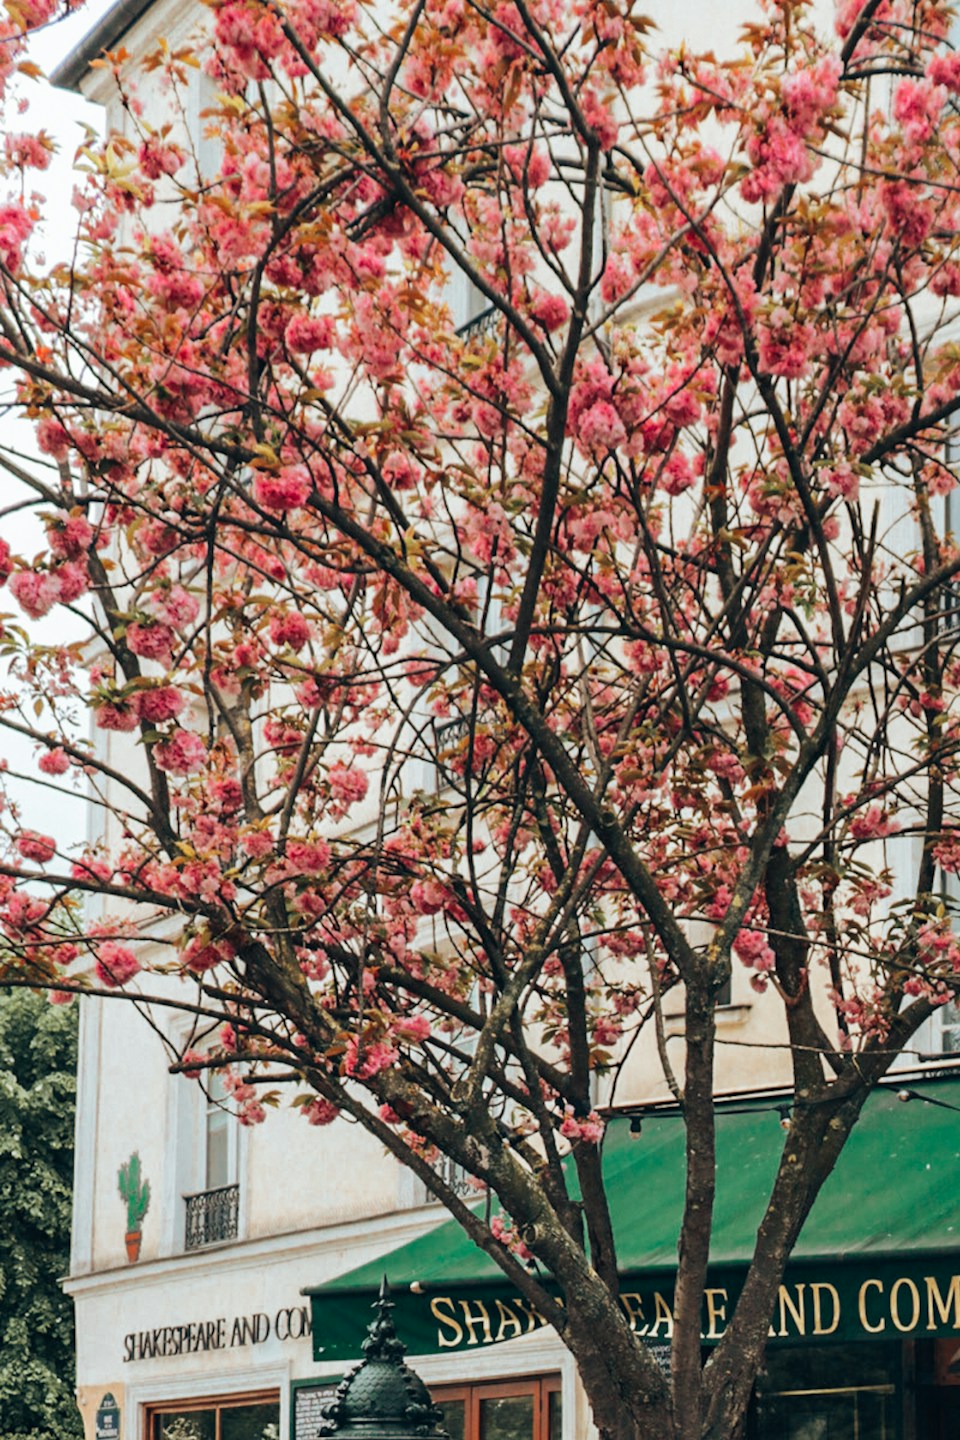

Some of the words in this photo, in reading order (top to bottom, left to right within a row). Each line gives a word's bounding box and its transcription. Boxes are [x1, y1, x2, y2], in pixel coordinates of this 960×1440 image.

[767, 1283, 841, 1337] ND
[123, 1319, 225, 1363] SHAKESPEARE
[230, 1313, 271, 1347] AND
